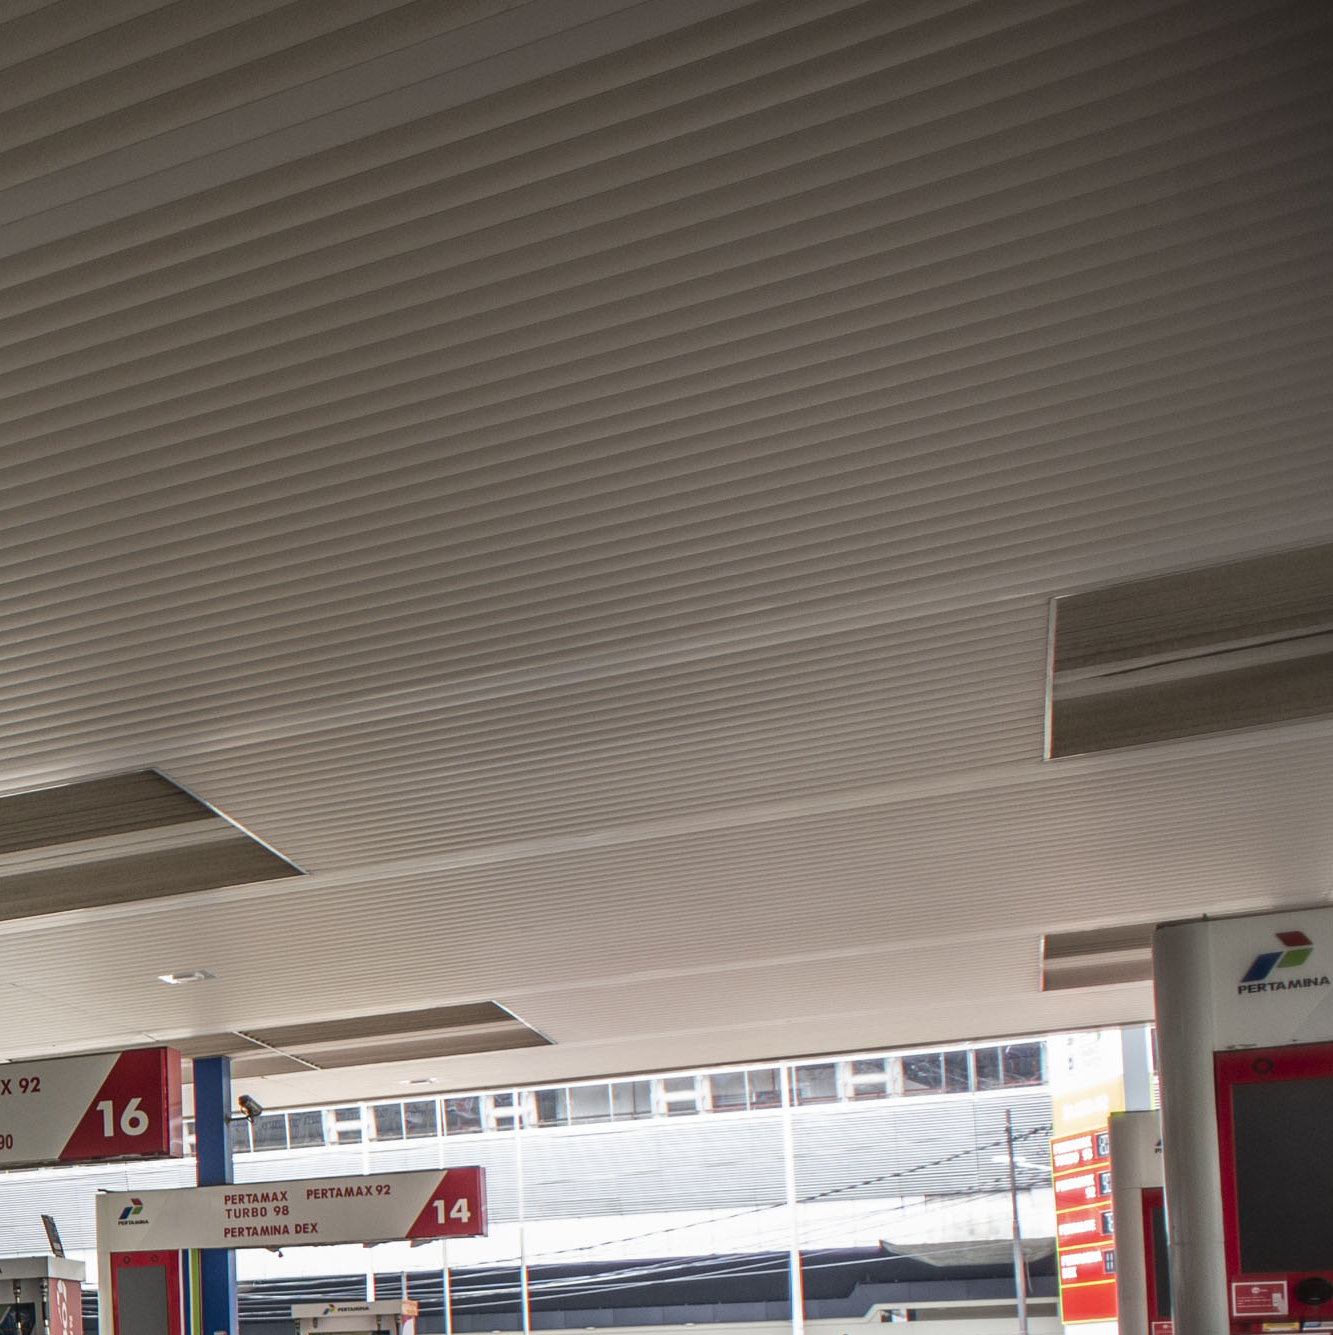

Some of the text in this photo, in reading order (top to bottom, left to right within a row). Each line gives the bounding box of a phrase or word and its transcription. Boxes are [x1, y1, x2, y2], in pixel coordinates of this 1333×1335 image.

[1237, 976, 1331, 994] PERTAMINA
[18, 1076, 41, 1094] 92
[96, 1097, 150, 1137] 16
[224, 1191, 288, 1206] PERTAMAX
[306, 1184, 391, 1200] PERTAMAX 92
[225, 1204, 290, 1219] TURBO 98
[431, 1198, 471, 1224] 14
[118, 1218, 149, 1226] PERTAMINA
[224, 1222, 319, 1239] PERTAMINA DEX
